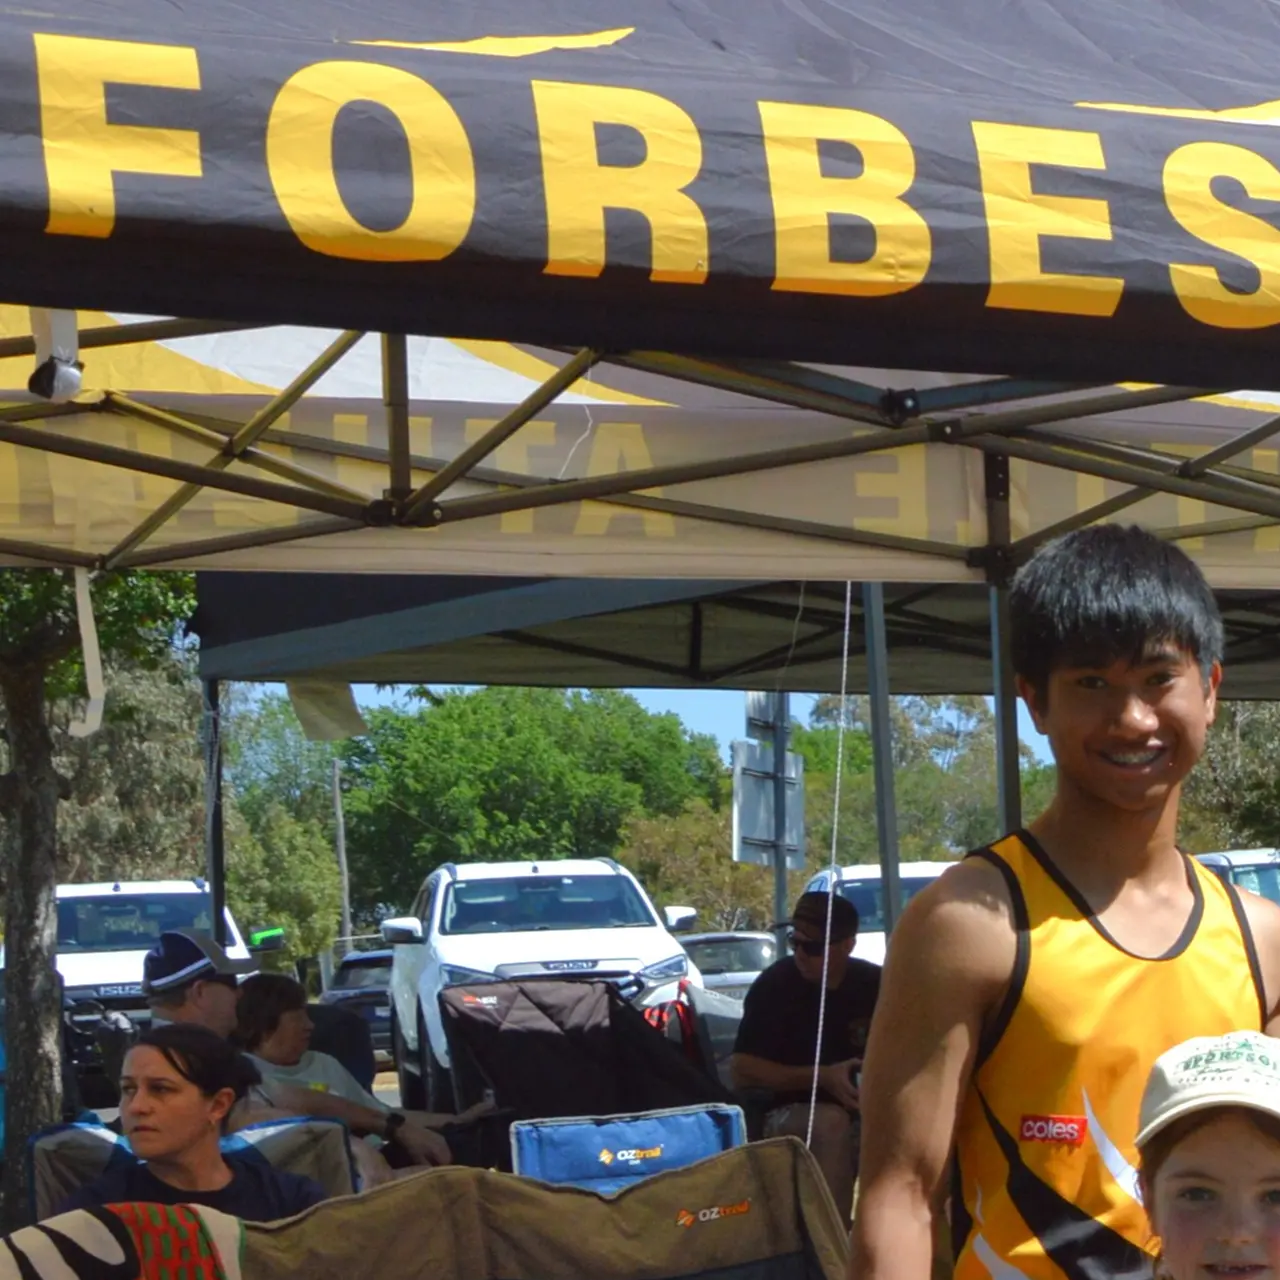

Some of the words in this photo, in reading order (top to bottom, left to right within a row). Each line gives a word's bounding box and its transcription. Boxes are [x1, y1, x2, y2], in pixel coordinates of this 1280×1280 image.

[99, 986, 142, 997] ISUZ
[1023, 1120, 1079, 1139] coles
[698, 1201, 750, 1222] OZtrail
